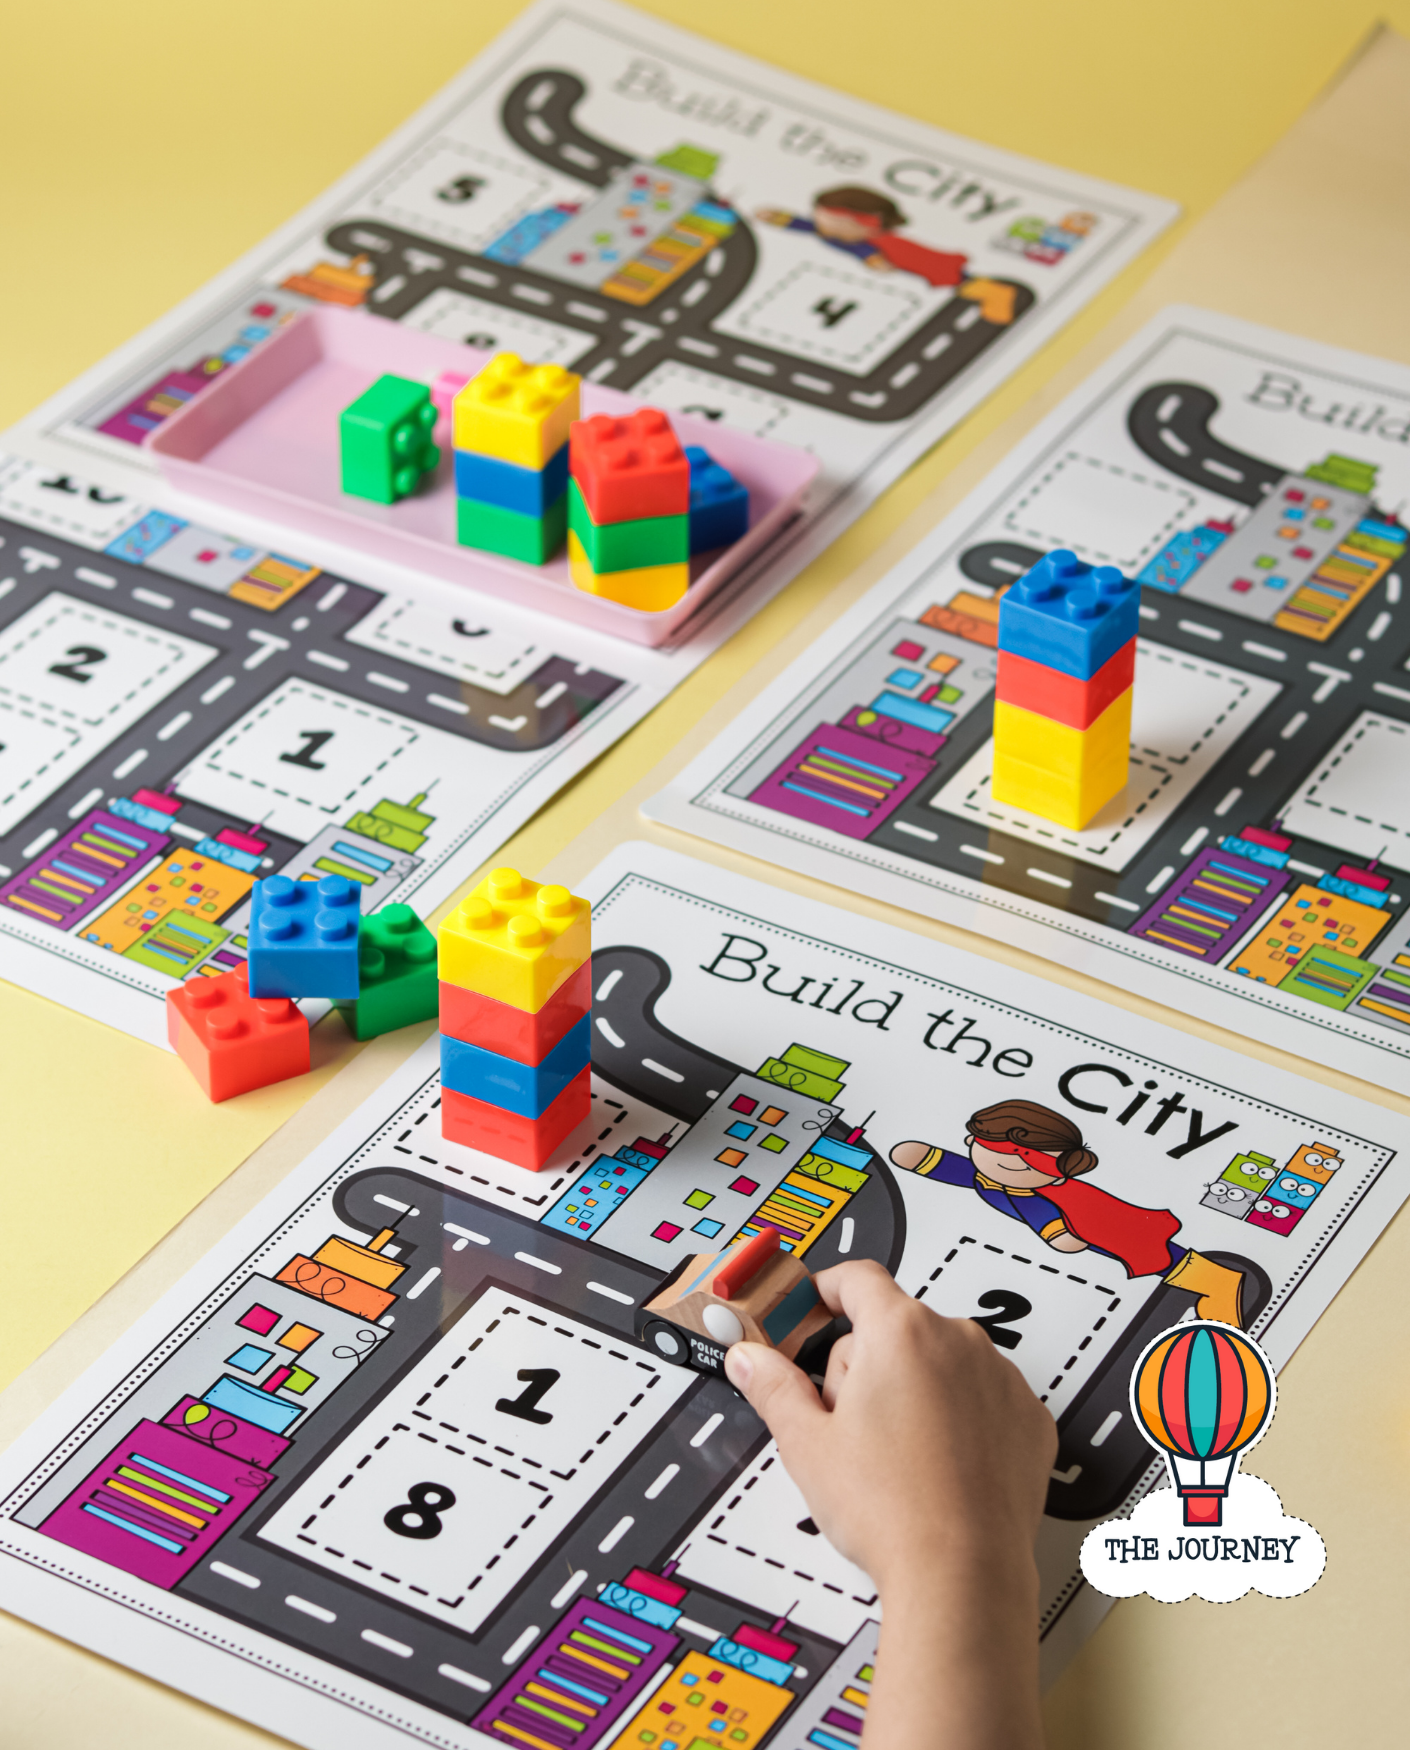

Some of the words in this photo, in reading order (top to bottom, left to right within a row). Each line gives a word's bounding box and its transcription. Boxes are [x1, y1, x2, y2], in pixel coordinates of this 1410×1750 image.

[612, 57, 771, 138] Build
[779, 121, 868, 172] the
[884, 159, 1021, 222] City
[437, 175, 485, 204] 5
[811, 296, 858, 329] 4
[47, 644, 109, 685] 2
[278, 729, 336, 771] 1
[699, 932, 904, 1031] Build
[922, 1008, 1034, 1078] the
[1057, 1062, 1240, 1160] City
[967, 1289, 1033, 1350] 2
[690, 1338, 725, 1361] POLICE
[697, 1352, 718, 1369] CAR
[494, 1367, 562, 1425] 1
[383, 1481, 457, 1540] 8
